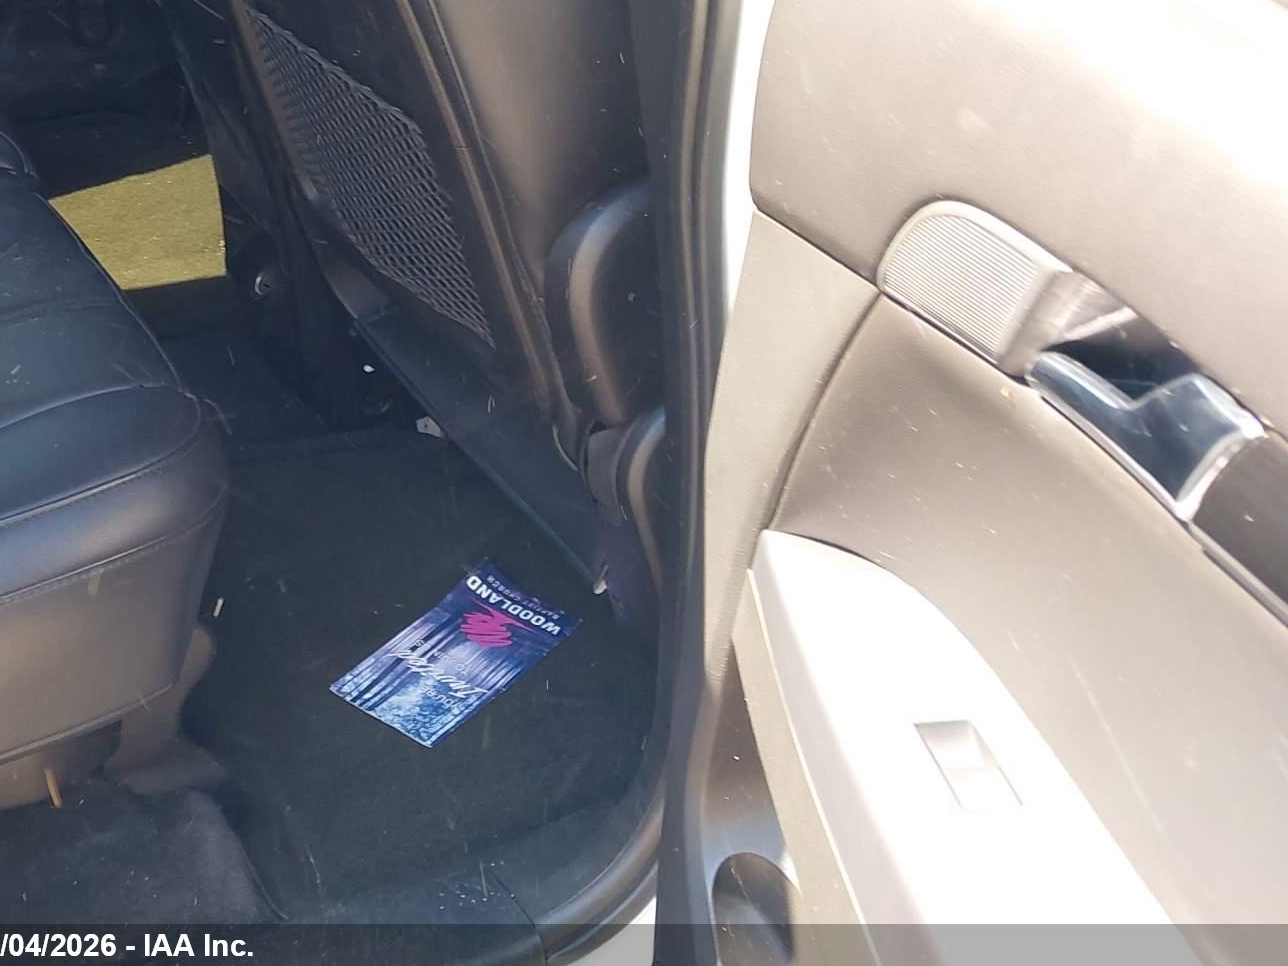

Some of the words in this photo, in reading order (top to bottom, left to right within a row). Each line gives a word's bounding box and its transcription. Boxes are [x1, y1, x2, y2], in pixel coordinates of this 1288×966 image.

[466, 575, 561, 635] WOODLAND
[486, 575, 521, 601] CHURCH
[382, 649, 489, 699] Invited
